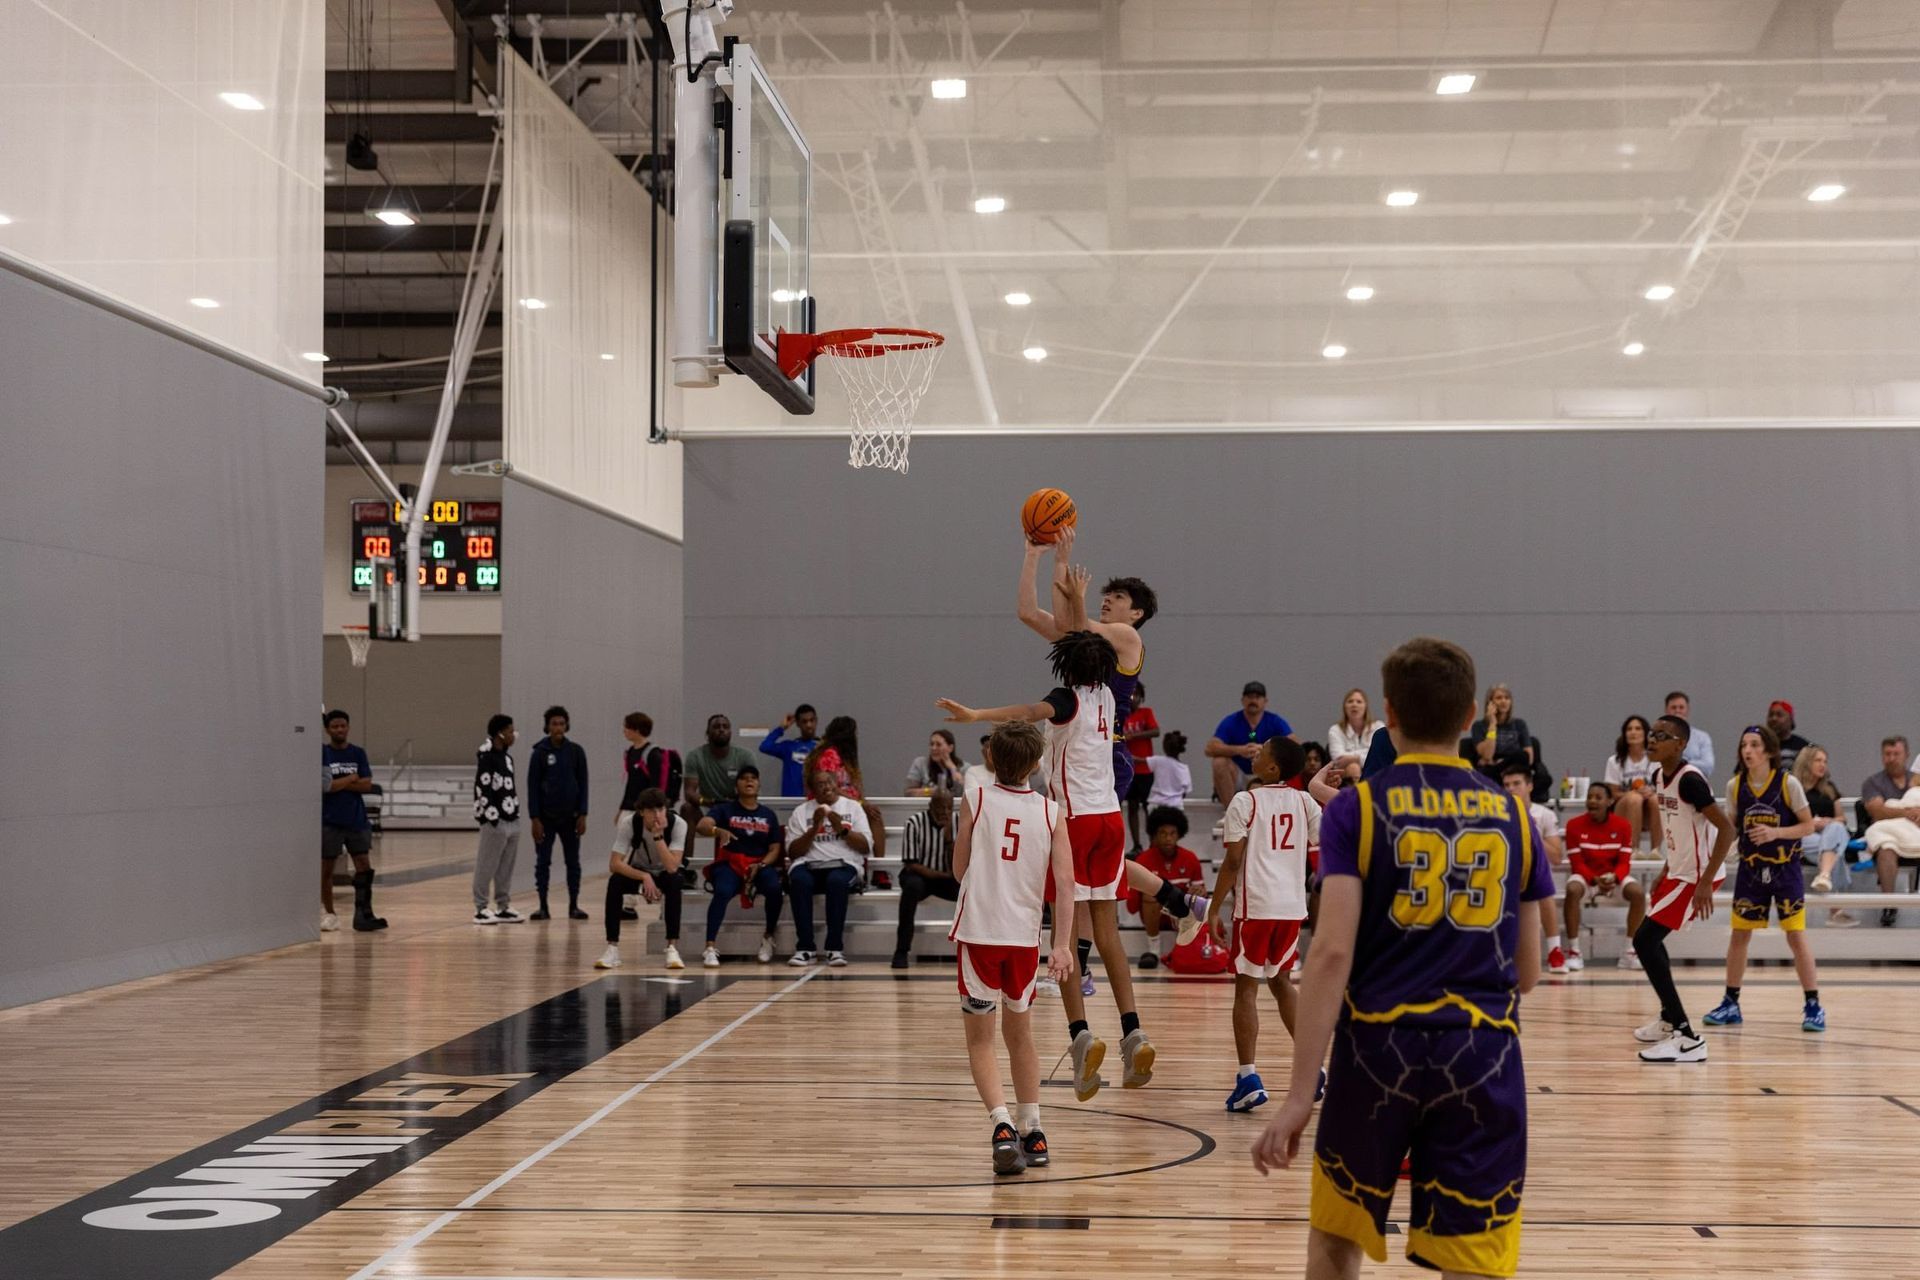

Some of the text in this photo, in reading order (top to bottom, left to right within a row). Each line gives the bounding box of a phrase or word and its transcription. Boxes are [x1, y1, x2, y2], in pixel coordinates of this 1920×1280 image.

[365, 537, 391, 558] 00
[433, 540, 445, 559] 0
[467, 537, 493, 558] 00
[476, 567, 498, 585] 00
[1097, 704, 1109, 741] 4
[1386, 785, 1511, 823] OLDACRE
[1001, 818, 1021, 862] 5
[1271, 813, 1295, 851] 12
[1387, 825, 1510, 932] 33
[82, 1071, 540, 1231] OMNIPLEX
